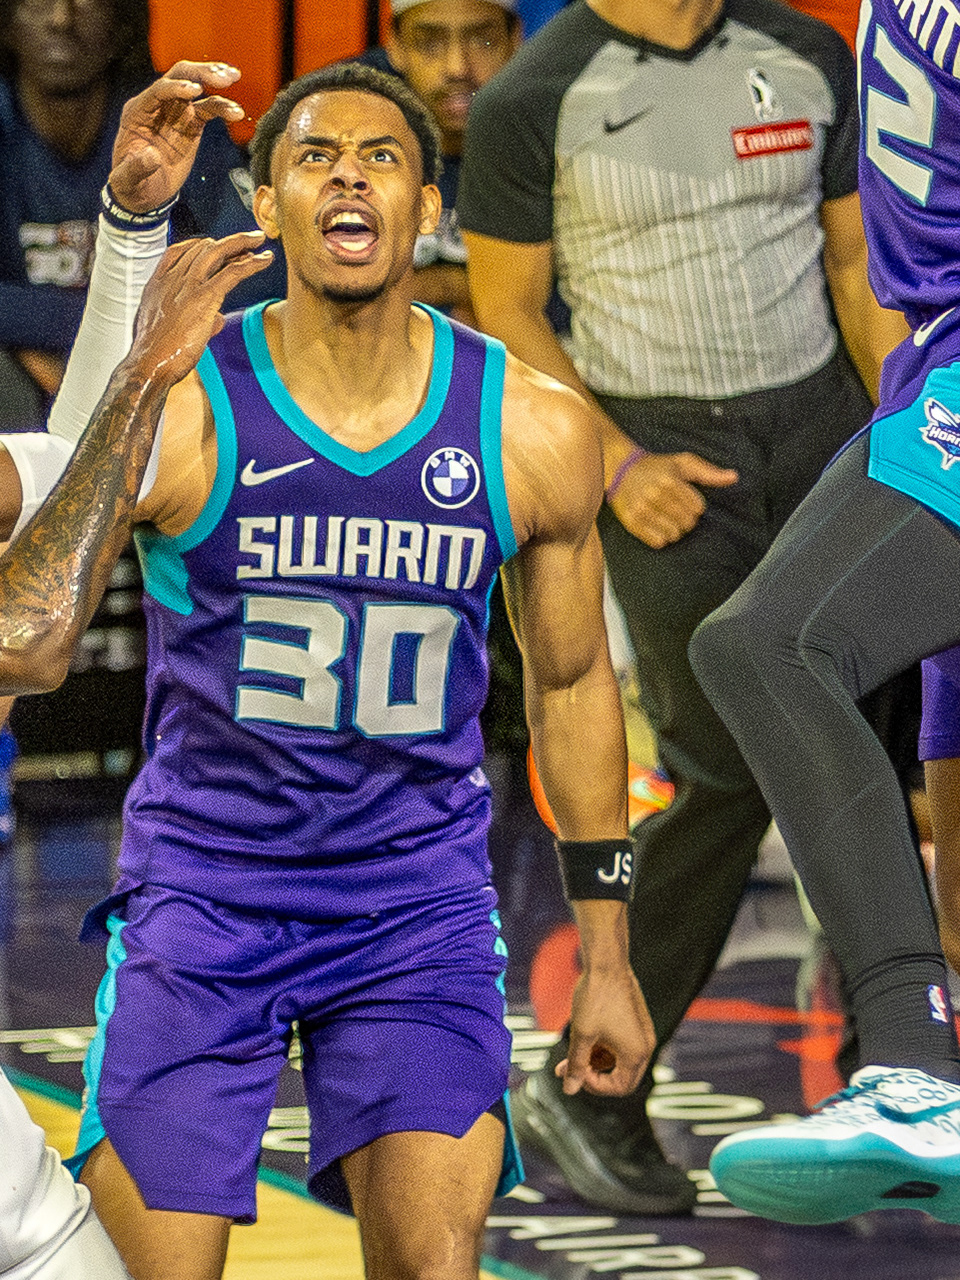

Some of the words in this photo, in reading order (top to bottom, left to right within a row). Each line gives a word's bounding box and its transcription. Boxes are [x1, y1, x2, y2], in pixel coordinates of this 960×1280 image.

[429, 450, 471, 469] BMW
[236, 515, 487, 590] SWARM
[234, 593, 463, 739] 30
[597, 851, 633, 885] JS
